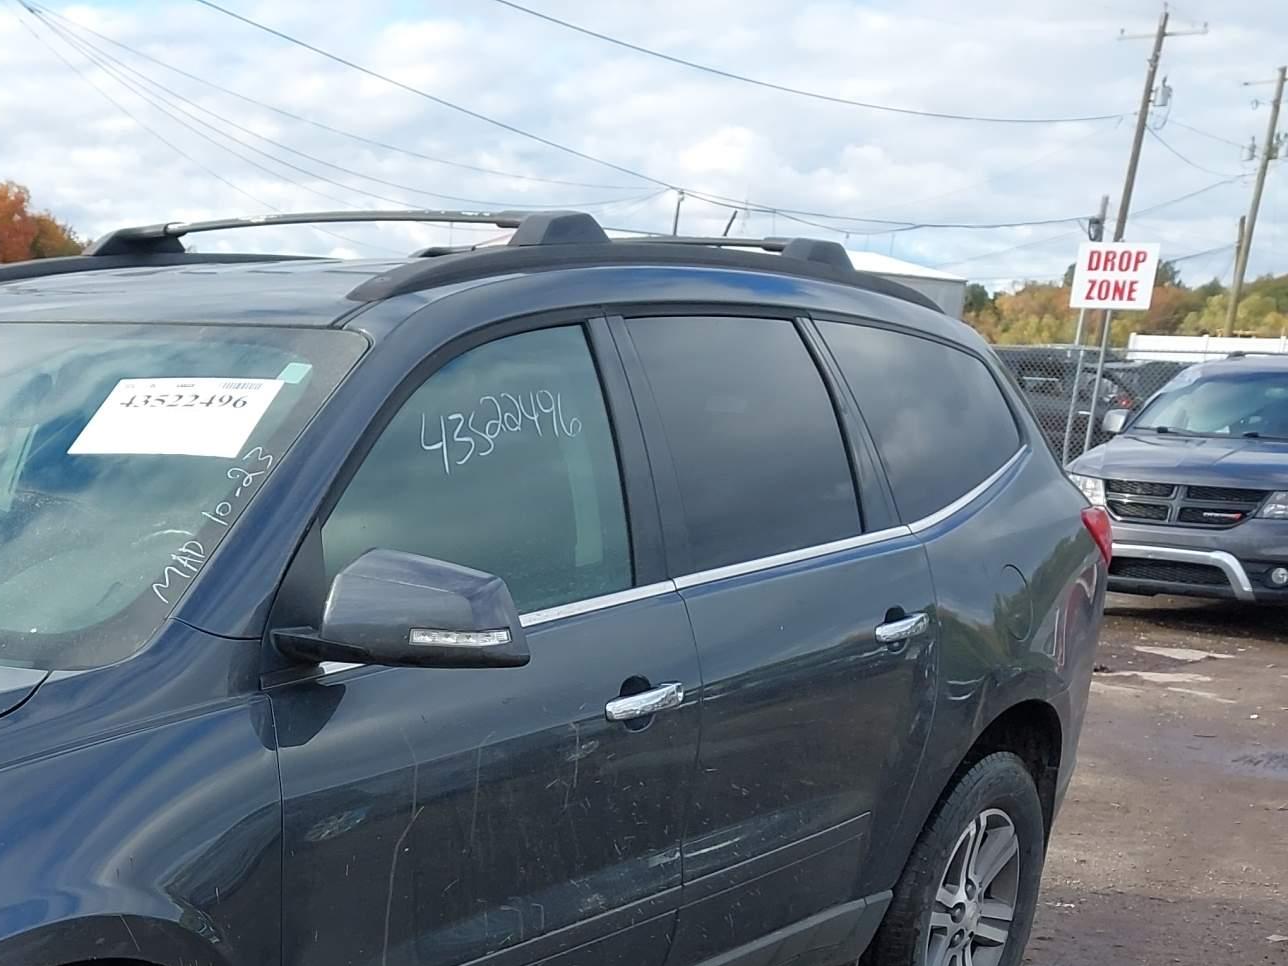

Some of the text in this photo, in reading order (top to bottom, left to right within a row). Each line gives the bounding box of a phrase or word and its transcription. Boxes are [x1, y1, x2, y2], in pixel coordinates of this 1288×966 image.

[1087, 250, 1148, 272] DROP
[1085, 279, 1139, 302] ZONE
[120, 394, 249, 409] 43522496
[420, 390, 582, 475] 43522496
[152, 446, 274, 604] MAD 10-23
